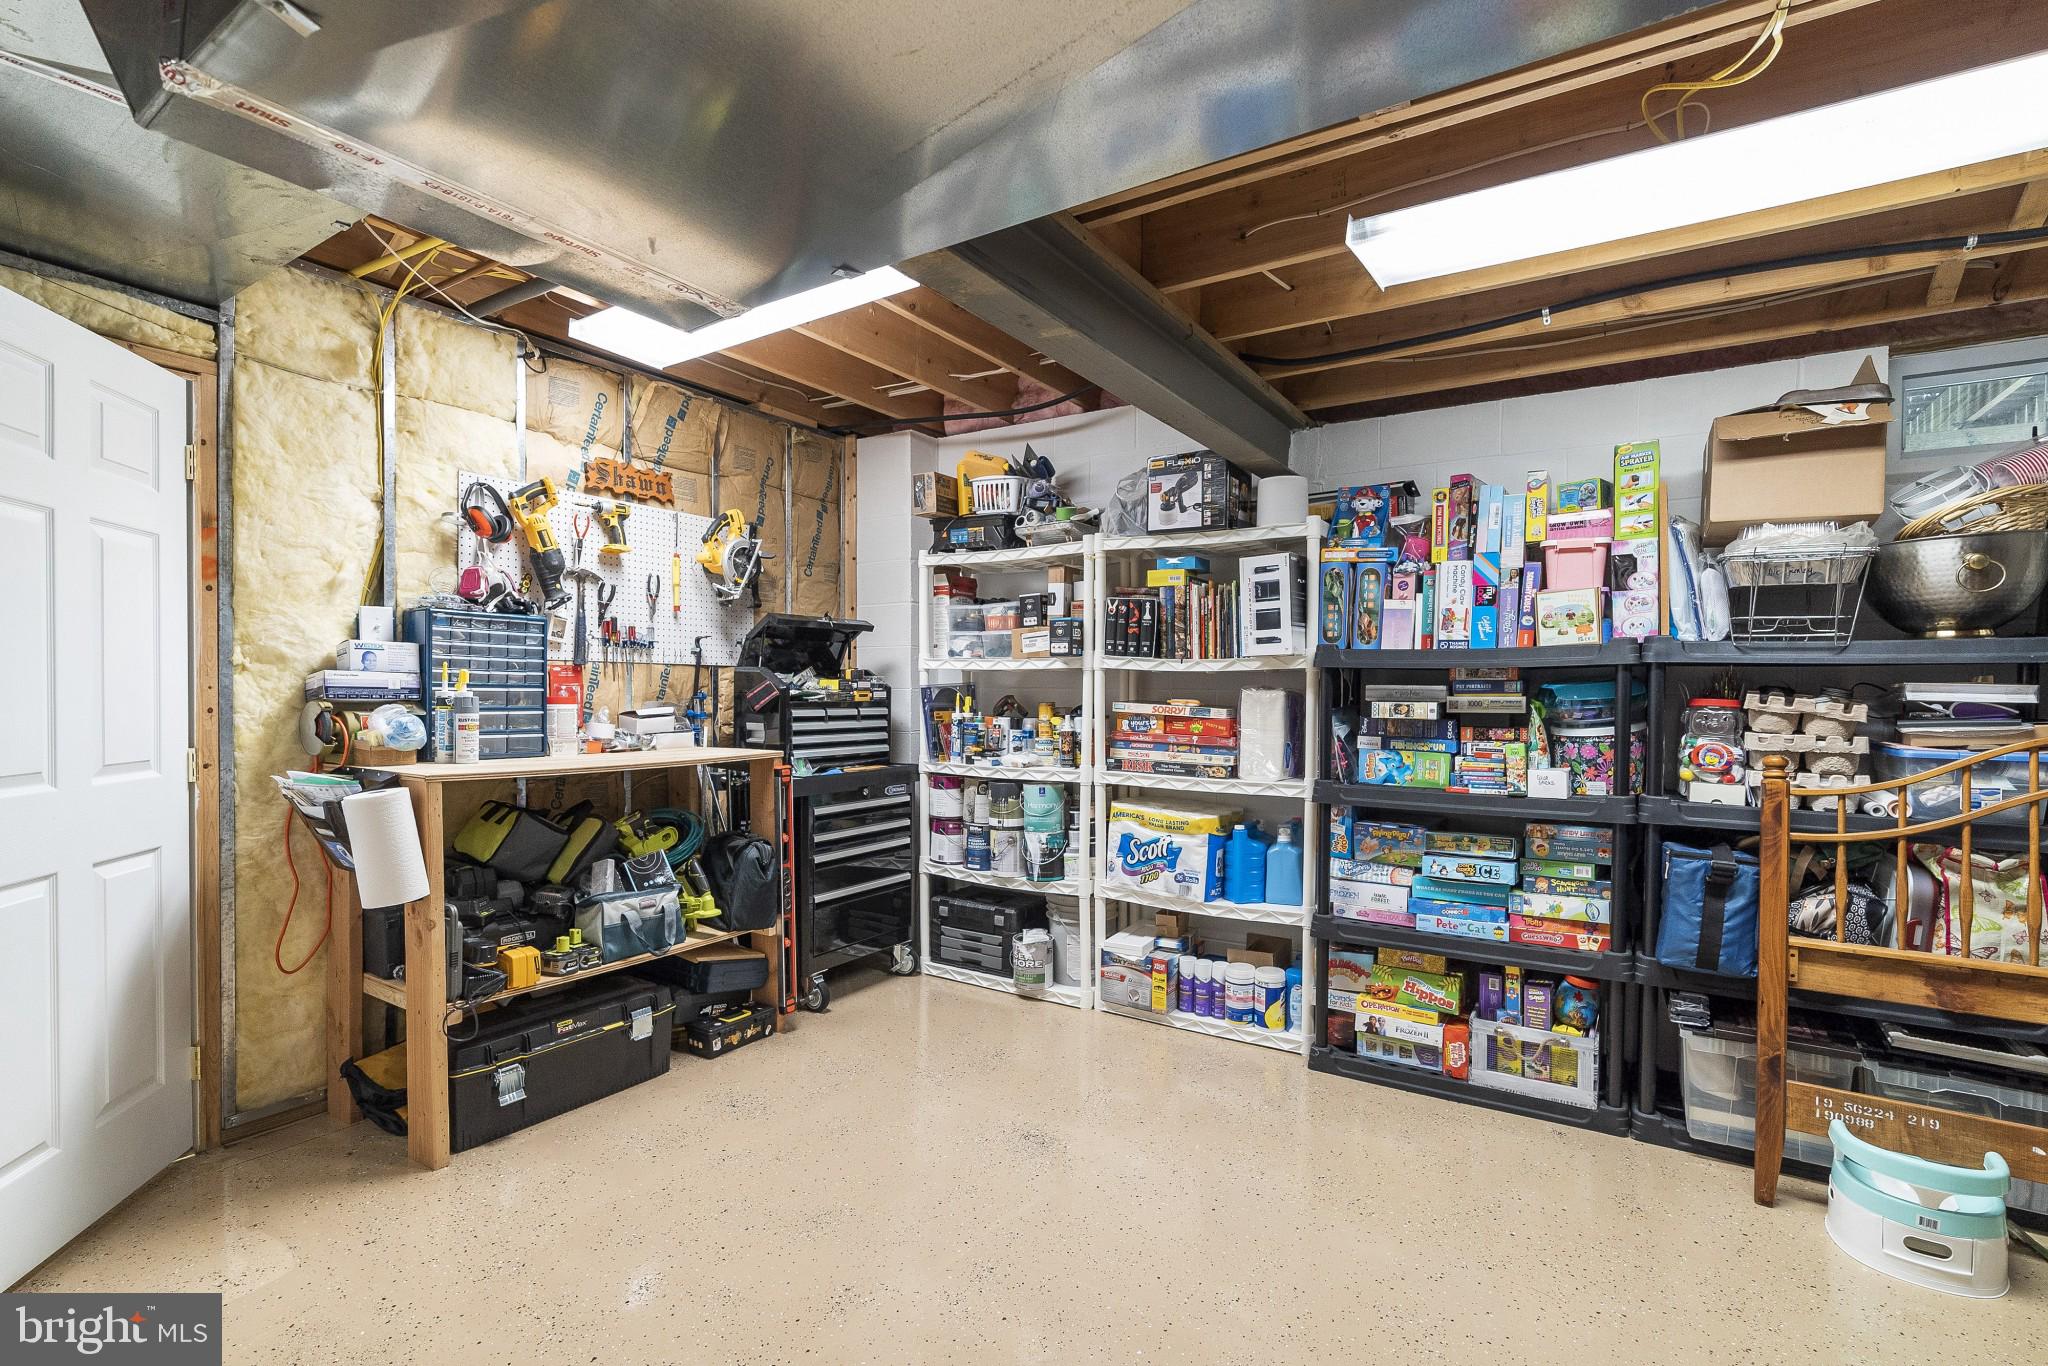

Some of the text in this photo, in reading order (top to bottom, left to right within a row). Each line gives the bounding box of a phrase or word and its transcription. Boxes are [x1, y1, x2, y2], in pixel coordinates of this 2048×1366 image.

[803, 520, 825, 578] CertainTeed
[1459, 564, 1467, 606] Candy Claw
[584, 661, 600, 712] ainTeed
[1151, 705, 1186, 716] SORRY!
[1121, 759, 1154, 774] RISK
[1112, 811, 1145, 821] AMERICA'S
[1126, 834, 1173, 865] Scott
[1474, 863, 1500, 879] ICE
[1435, 917, 1459, 930] Pete
[1467, 922, 1487, 934] Cat
[1360, 1000, 1401, 1013] OPERATION
[1395, 1026, 1423, 1038] FROZEN
[1843, 1101, 1894, 1121] 56224
[1907, 1113, 1940, 1130] 219
